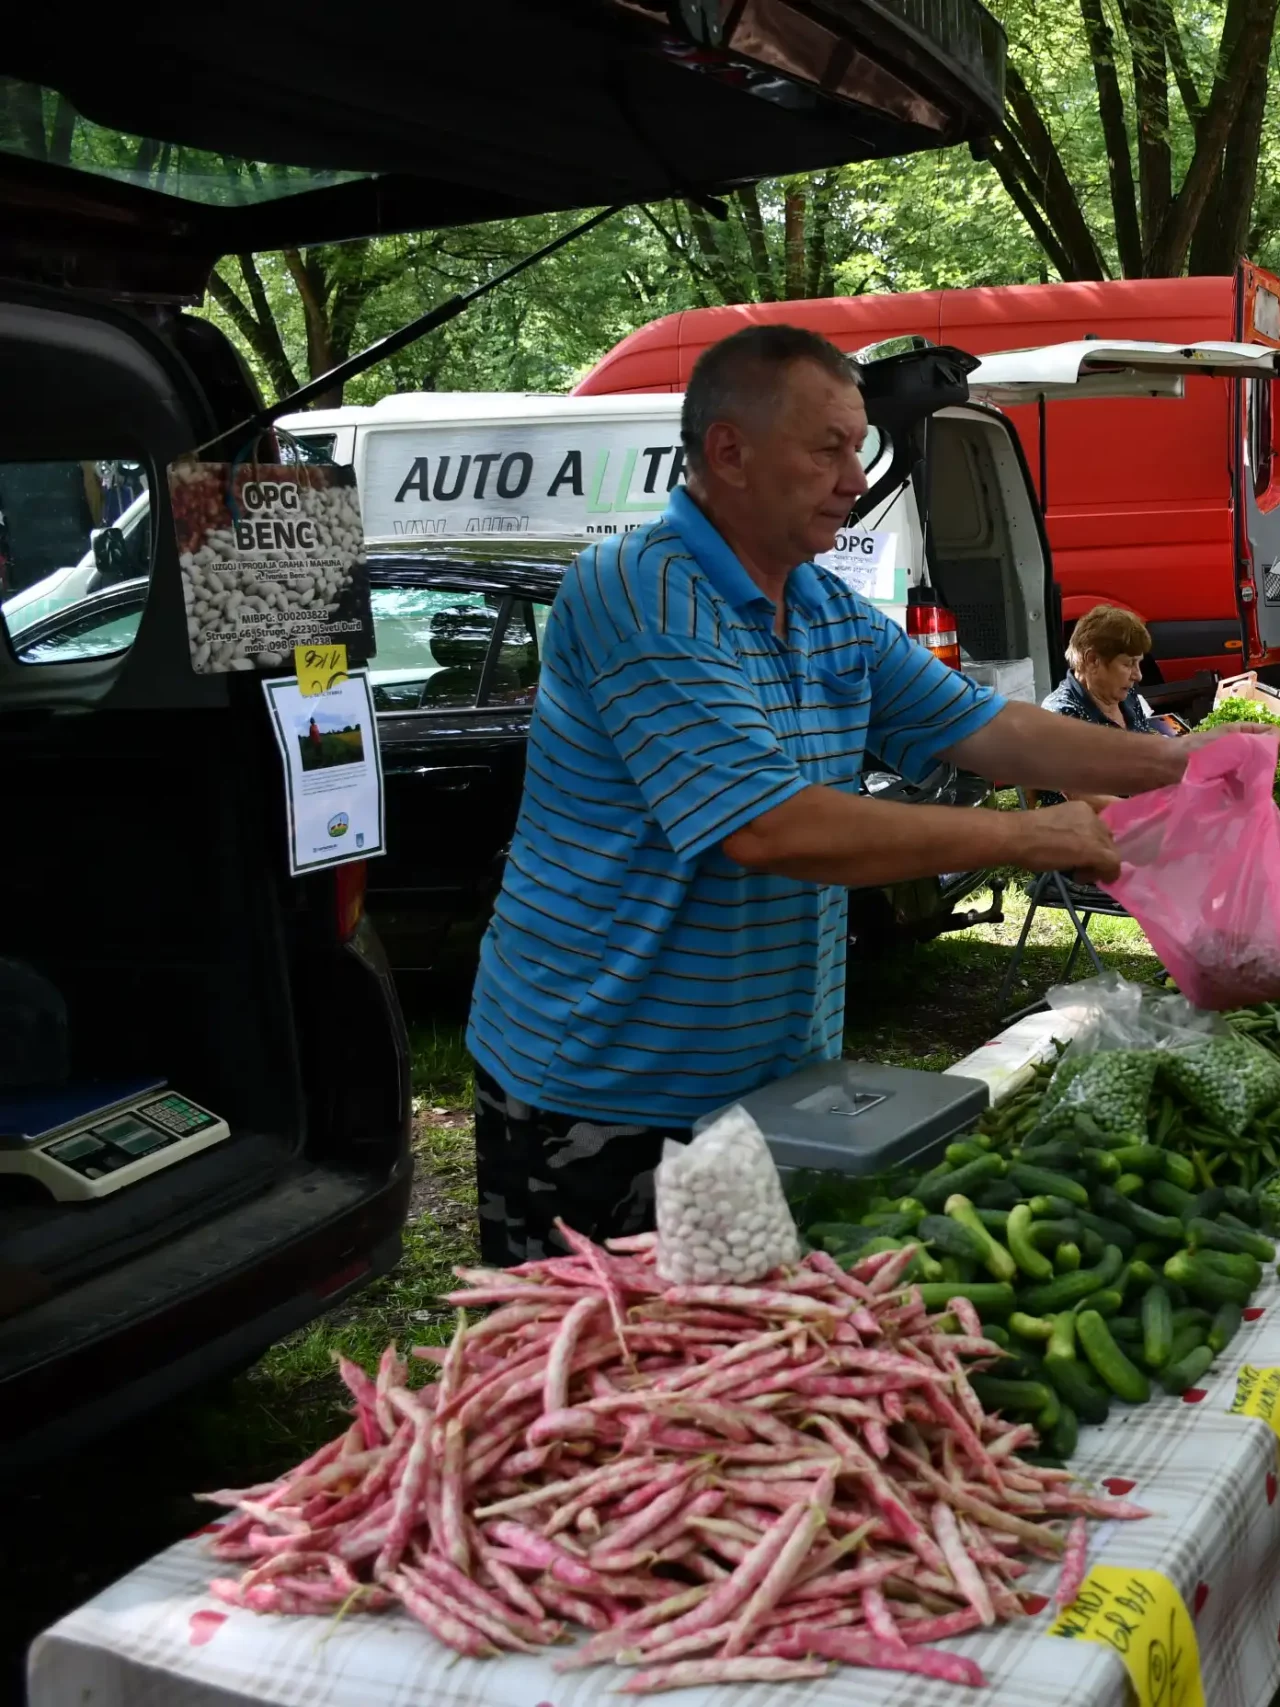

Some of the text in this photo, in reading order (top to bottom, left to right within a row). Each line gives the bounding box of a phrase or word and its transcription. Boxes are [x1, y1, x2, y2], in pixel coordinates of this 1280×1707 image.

[394, 451, 533, 502] AUTO
[243, 484, 299, 510] OPG
[235, 520, 315, 551] BENC
[834, 533, 875, 555] OPG
[212, 562, 236, 571] UZGOJ
[242, 561, 277, 570] PRODAJA
[279, 560, 304, 569] GRAHA
[309, 559, 341, 567] MAHUNA
[242, 610, 328, 624] MIBPG: 000203822
[206, 631, 237, 642] Struga
[290, 625, 318, 636] 42230
[319, 623, 340, 633] Sveti
[244, 642, 267, 652] mob:
[269, 640, 288, 650] 098
